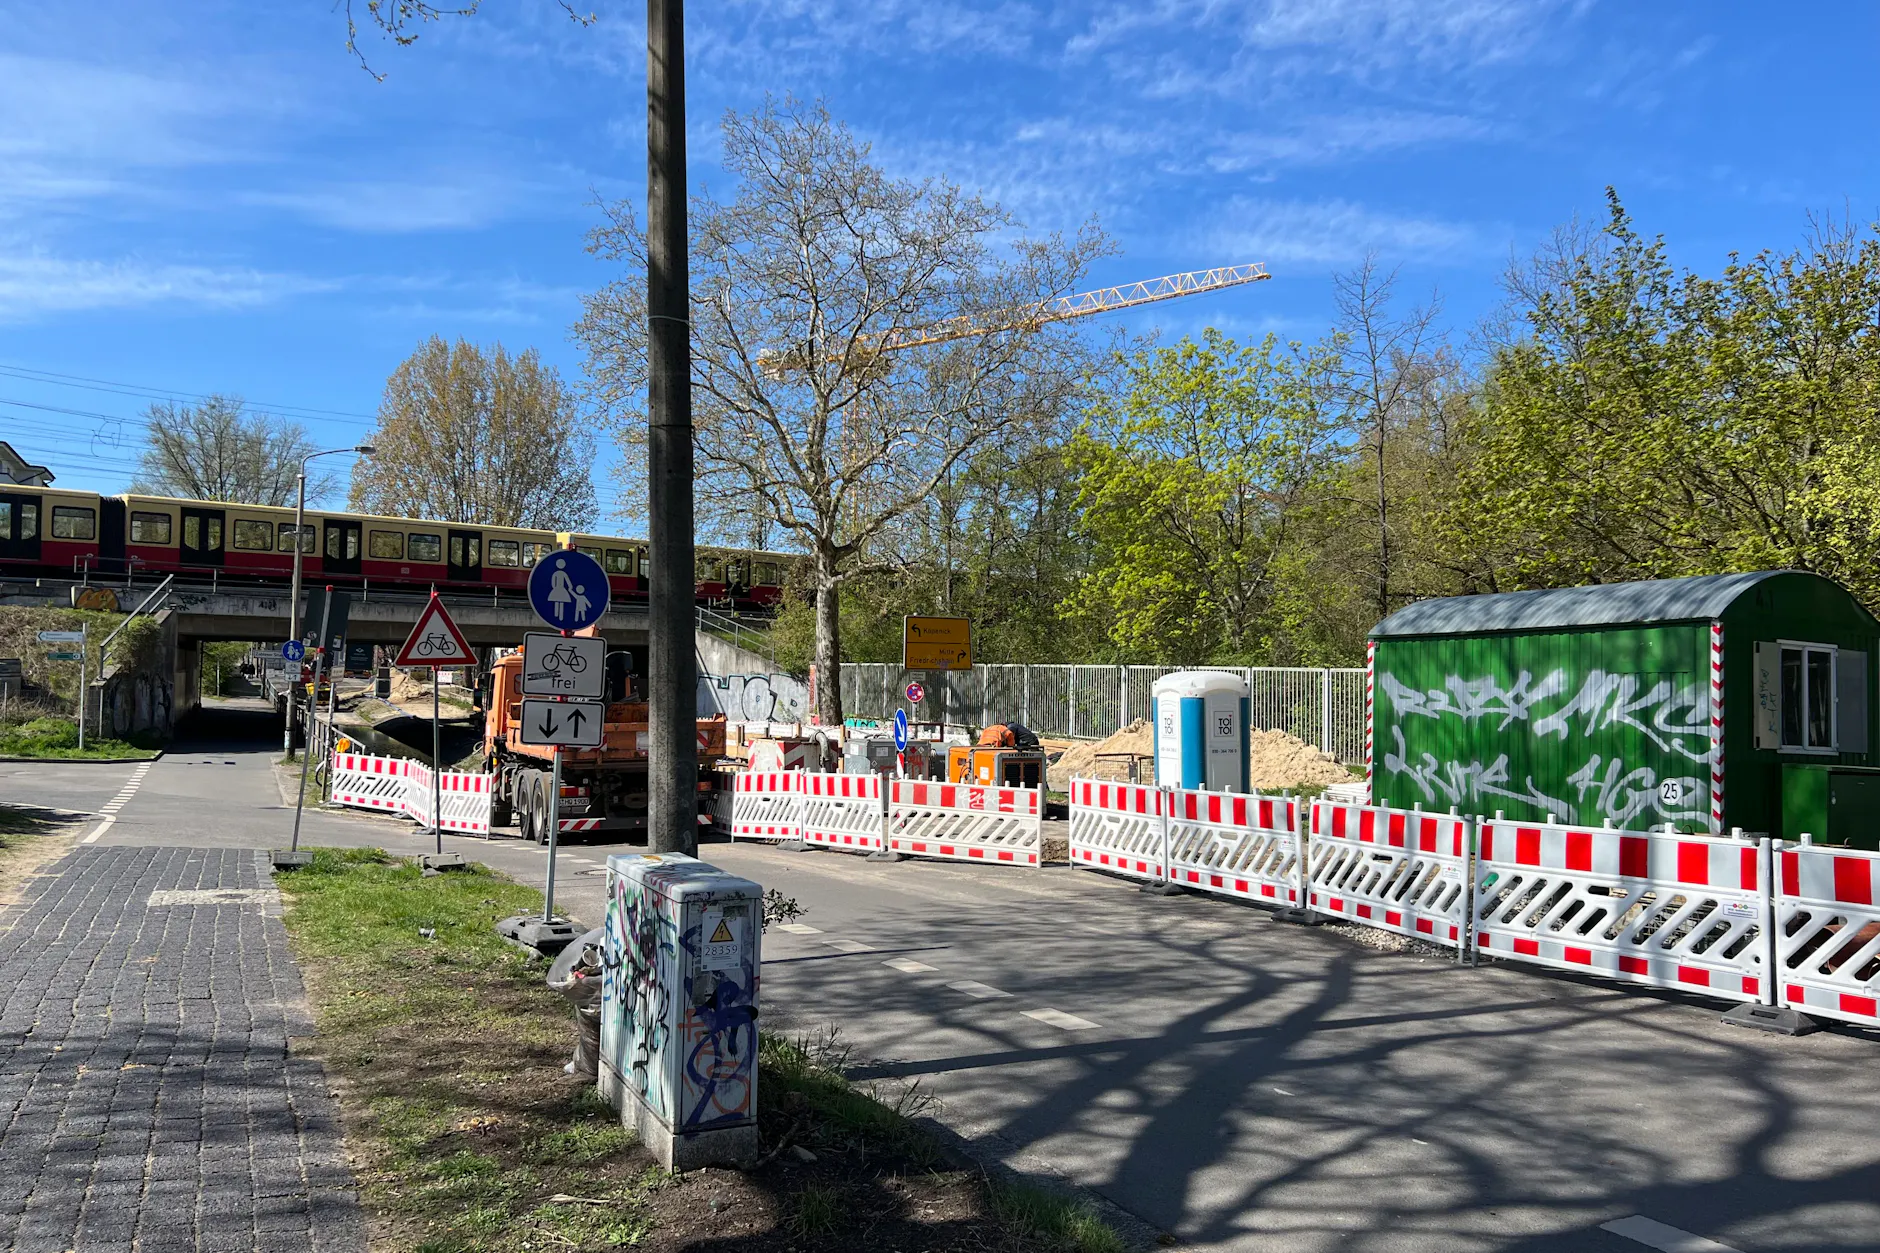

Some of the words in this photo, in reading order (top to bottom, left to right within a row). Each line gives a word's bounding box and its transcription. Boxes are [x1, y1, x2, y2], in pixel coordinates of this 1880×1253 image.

[923, 627, 952, 635] Köpenick
[551, 676, 576, 689] frei
[1163, 717, 1174, 726] TOI
[1218, 717, 1232, 727] TOI
[1163, 726, 1174, 735] TOI
[1218, 726, 1232, 735] TOI
[1663, 783, 1678, 800] 25
[705, 945, 738, 956] 28359
